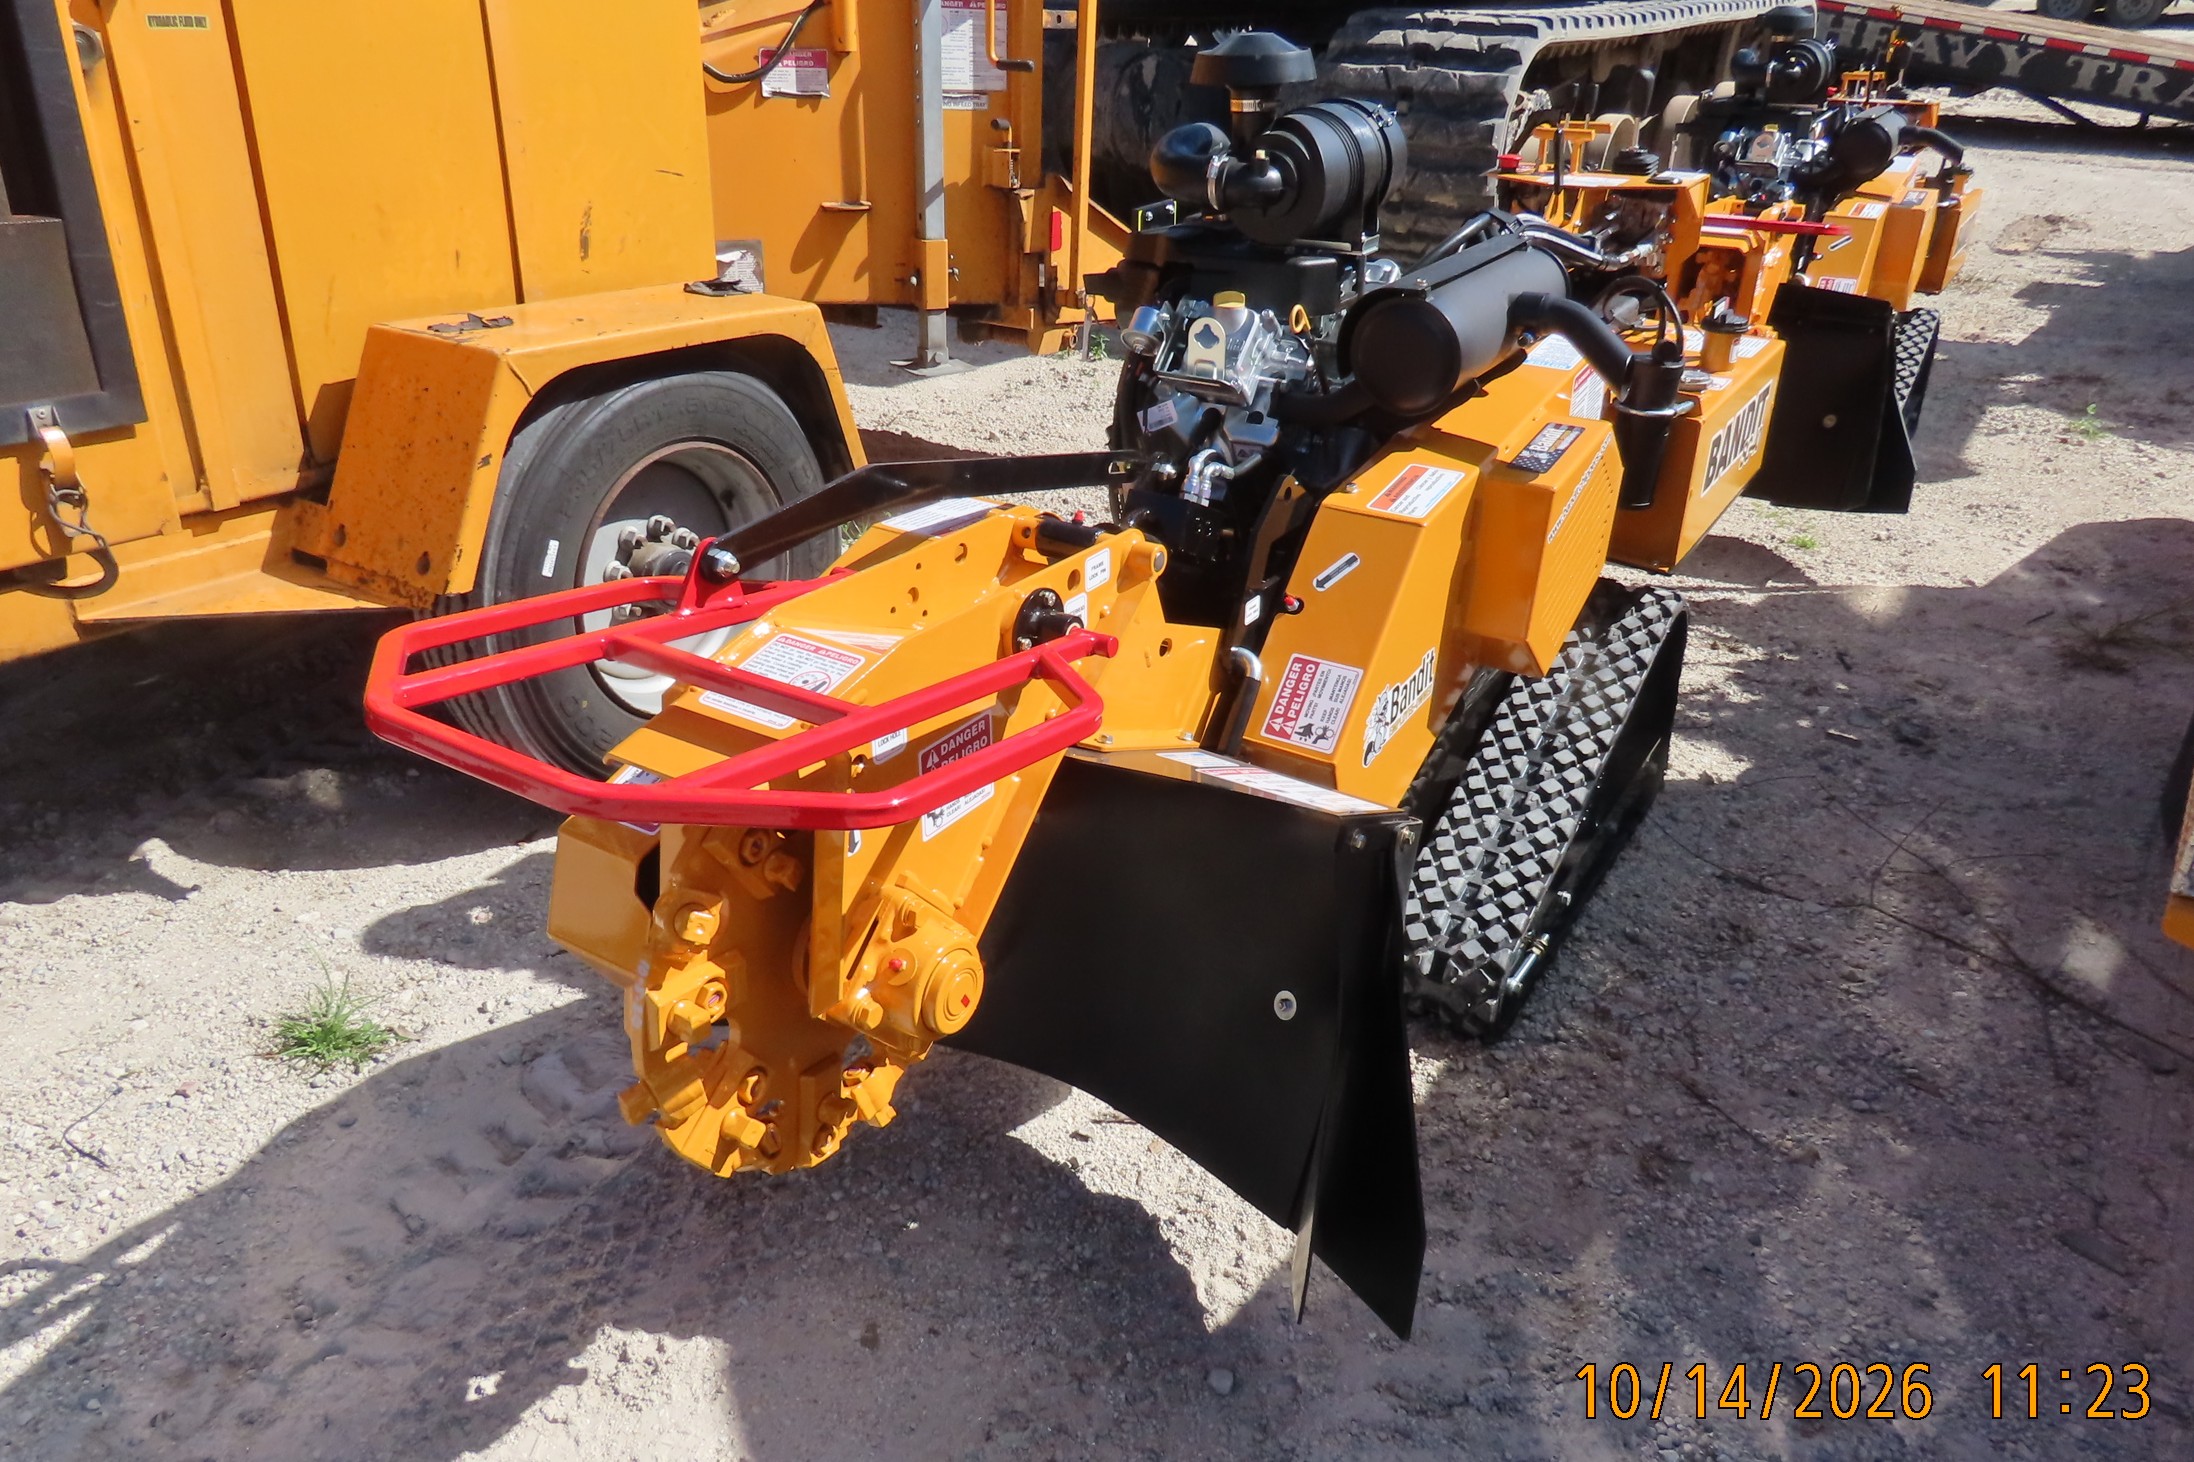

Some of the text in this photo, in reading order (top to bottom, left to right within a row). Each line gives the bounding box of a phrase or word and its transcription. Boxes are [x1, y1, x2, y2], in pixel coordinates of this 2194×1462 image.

[1818, 12, 2049, 78] HEAVY
[1702, 382, 1771, 495] BANDIT
[785, 638, 859, 665] DANGER PELIGRO
[1274, 662, 1303, 715] DANGER
[1287, 663, 1316, 719] PELIGRO
[1338, 675, 1347, 694] MANOS
[1389, 650, 1435, 725] Bandit
[1304, 699, 1315, 718] MOVING
[1325, 707, 1335, 723] HANDS
[877, 738, 890, 748] LOCK
[940, 719, 986, 756] DANGER
